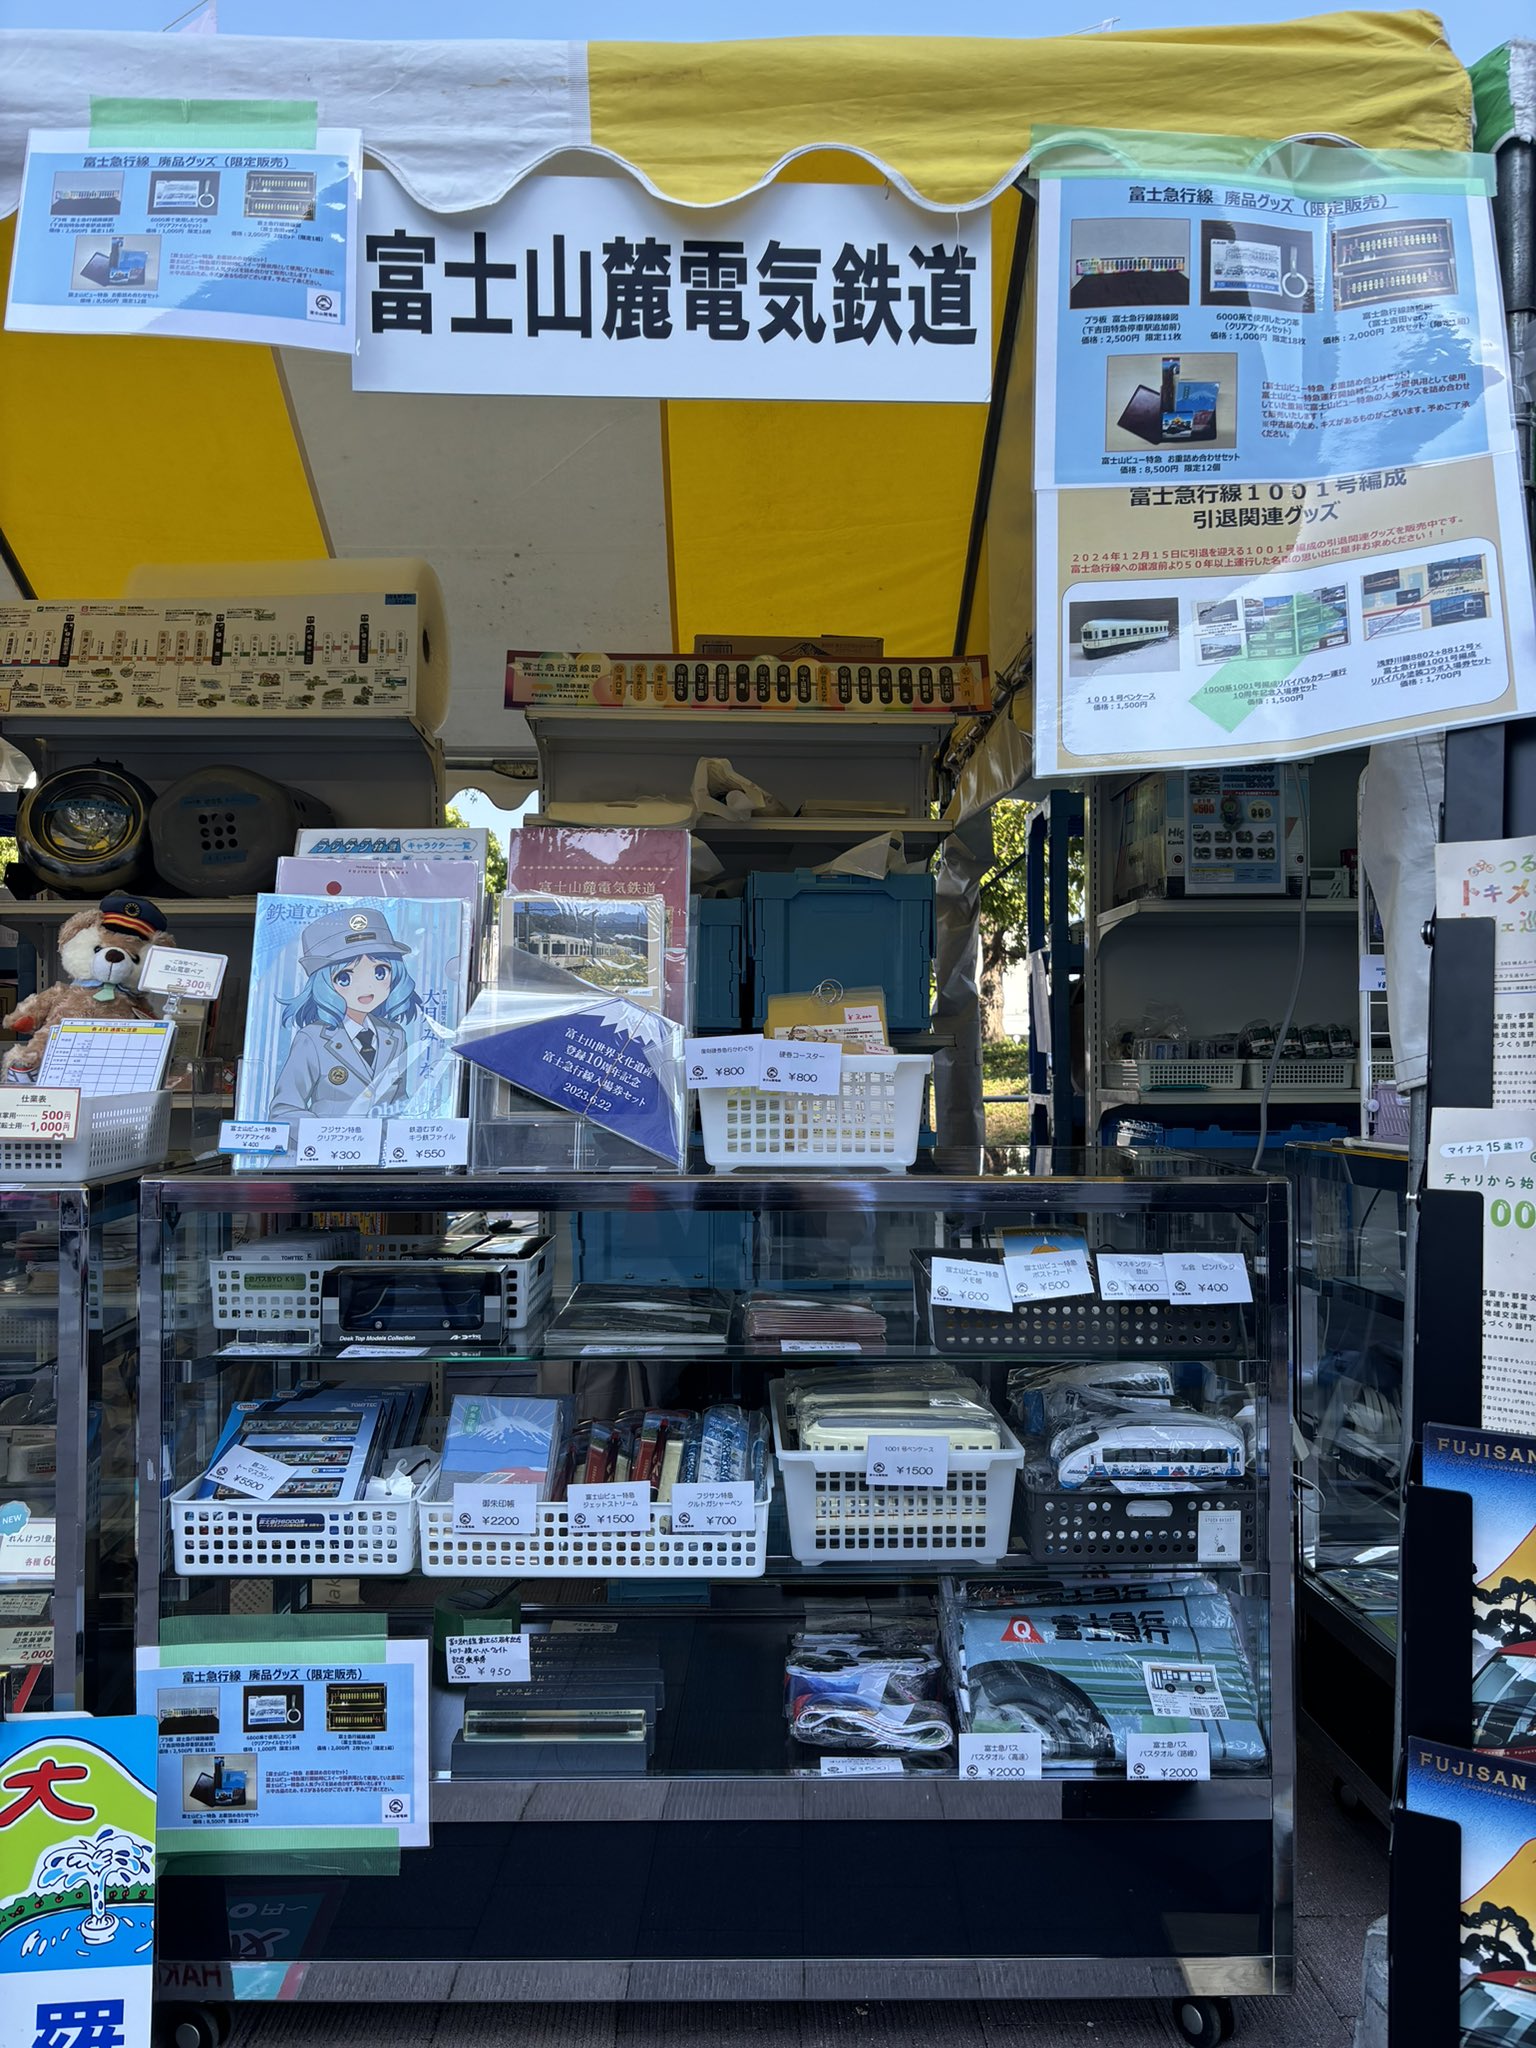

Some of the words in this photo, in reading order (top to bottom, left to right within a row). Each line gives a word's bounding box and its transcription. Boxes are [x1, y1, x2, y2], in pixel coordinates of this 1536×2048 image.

[1128, 185, 1214, 204] 富士急行線
[365, 229, 978, 346] 富士山麓電気鉄道
[1193, 500, 1341, 529] 引退関連グッズ
[538, 881, 657, 896] 富士山麓電気鉄道
[564, 1043, 641, 1090] 登録10周年記念
[715, 1066, 745, 1076] ¥800
[788, 1073, 818, 1083] ¥800
[21, 1094, 47, 1104] 仕業表
[562, 1082, 612, 1112] 2023.6.22
[41, 1110, 72, 1121] 500円
[30, 1121, 70, 1133] 1,000円
[321, 1126, 362, 1134] フジサン特急
[316, 1134, 365, 1142] クリアファイル
[331, 1150, 361, 1160] ¥300
[415, 1149, 446, 1159] ¥550
[1039, 1280, 1071, 1291] ¥500
[1197, 1282, 1229, 1293] ¥400
[959, 1290, 990, 1302] ¥600
[896, 1466, 934, 1476] ¥1500
[233, 1474, 265, 1492] ¥5500
[696, 1492, 734, 1500] フジサン特急
[482, 1499, 516, 1509] 御朱印帳
[2, 1513, 22, 1525] NEW
[482, 1515, 520, 1526] ¥2200
[597, 1513, 635, 1524] ¥1500
[706, 1515, 737, 1526] ¥700
[182, 1670, 241, 1683] 富士急行線
[983, 1743, 1020, 1752] 富士急バス
[1152, 1740, 1188, 1749] 富士急バス
[987, 1767, 1026, 1778] ¥2000
[1160, 1767, 1199, 1778] ¥2000
[1418, 1751, 1528, 1792] FUJISAN
